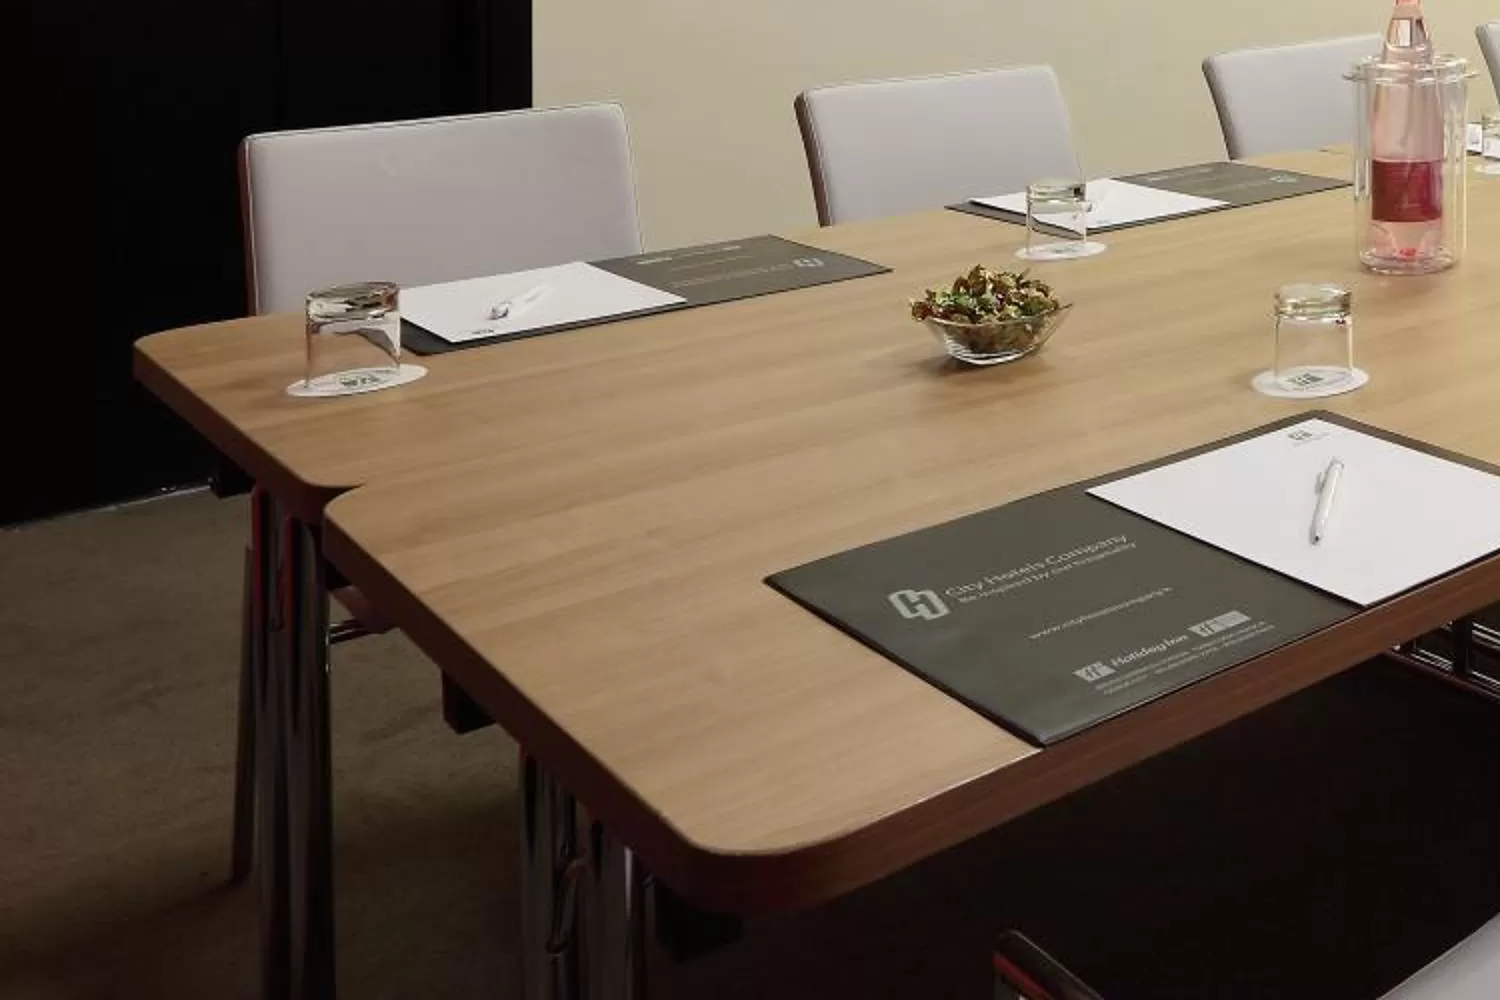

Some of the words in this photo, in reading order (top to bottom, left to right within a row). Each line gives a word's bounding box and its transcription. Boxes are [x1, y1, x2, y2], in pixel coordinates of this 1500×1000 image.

[945, 580, 983, 598] City
[984, 562, 1046, 586] Hotels
[1045, 534, 1128, 566] Company
[1111, 640, 1166, 667] Holiday
